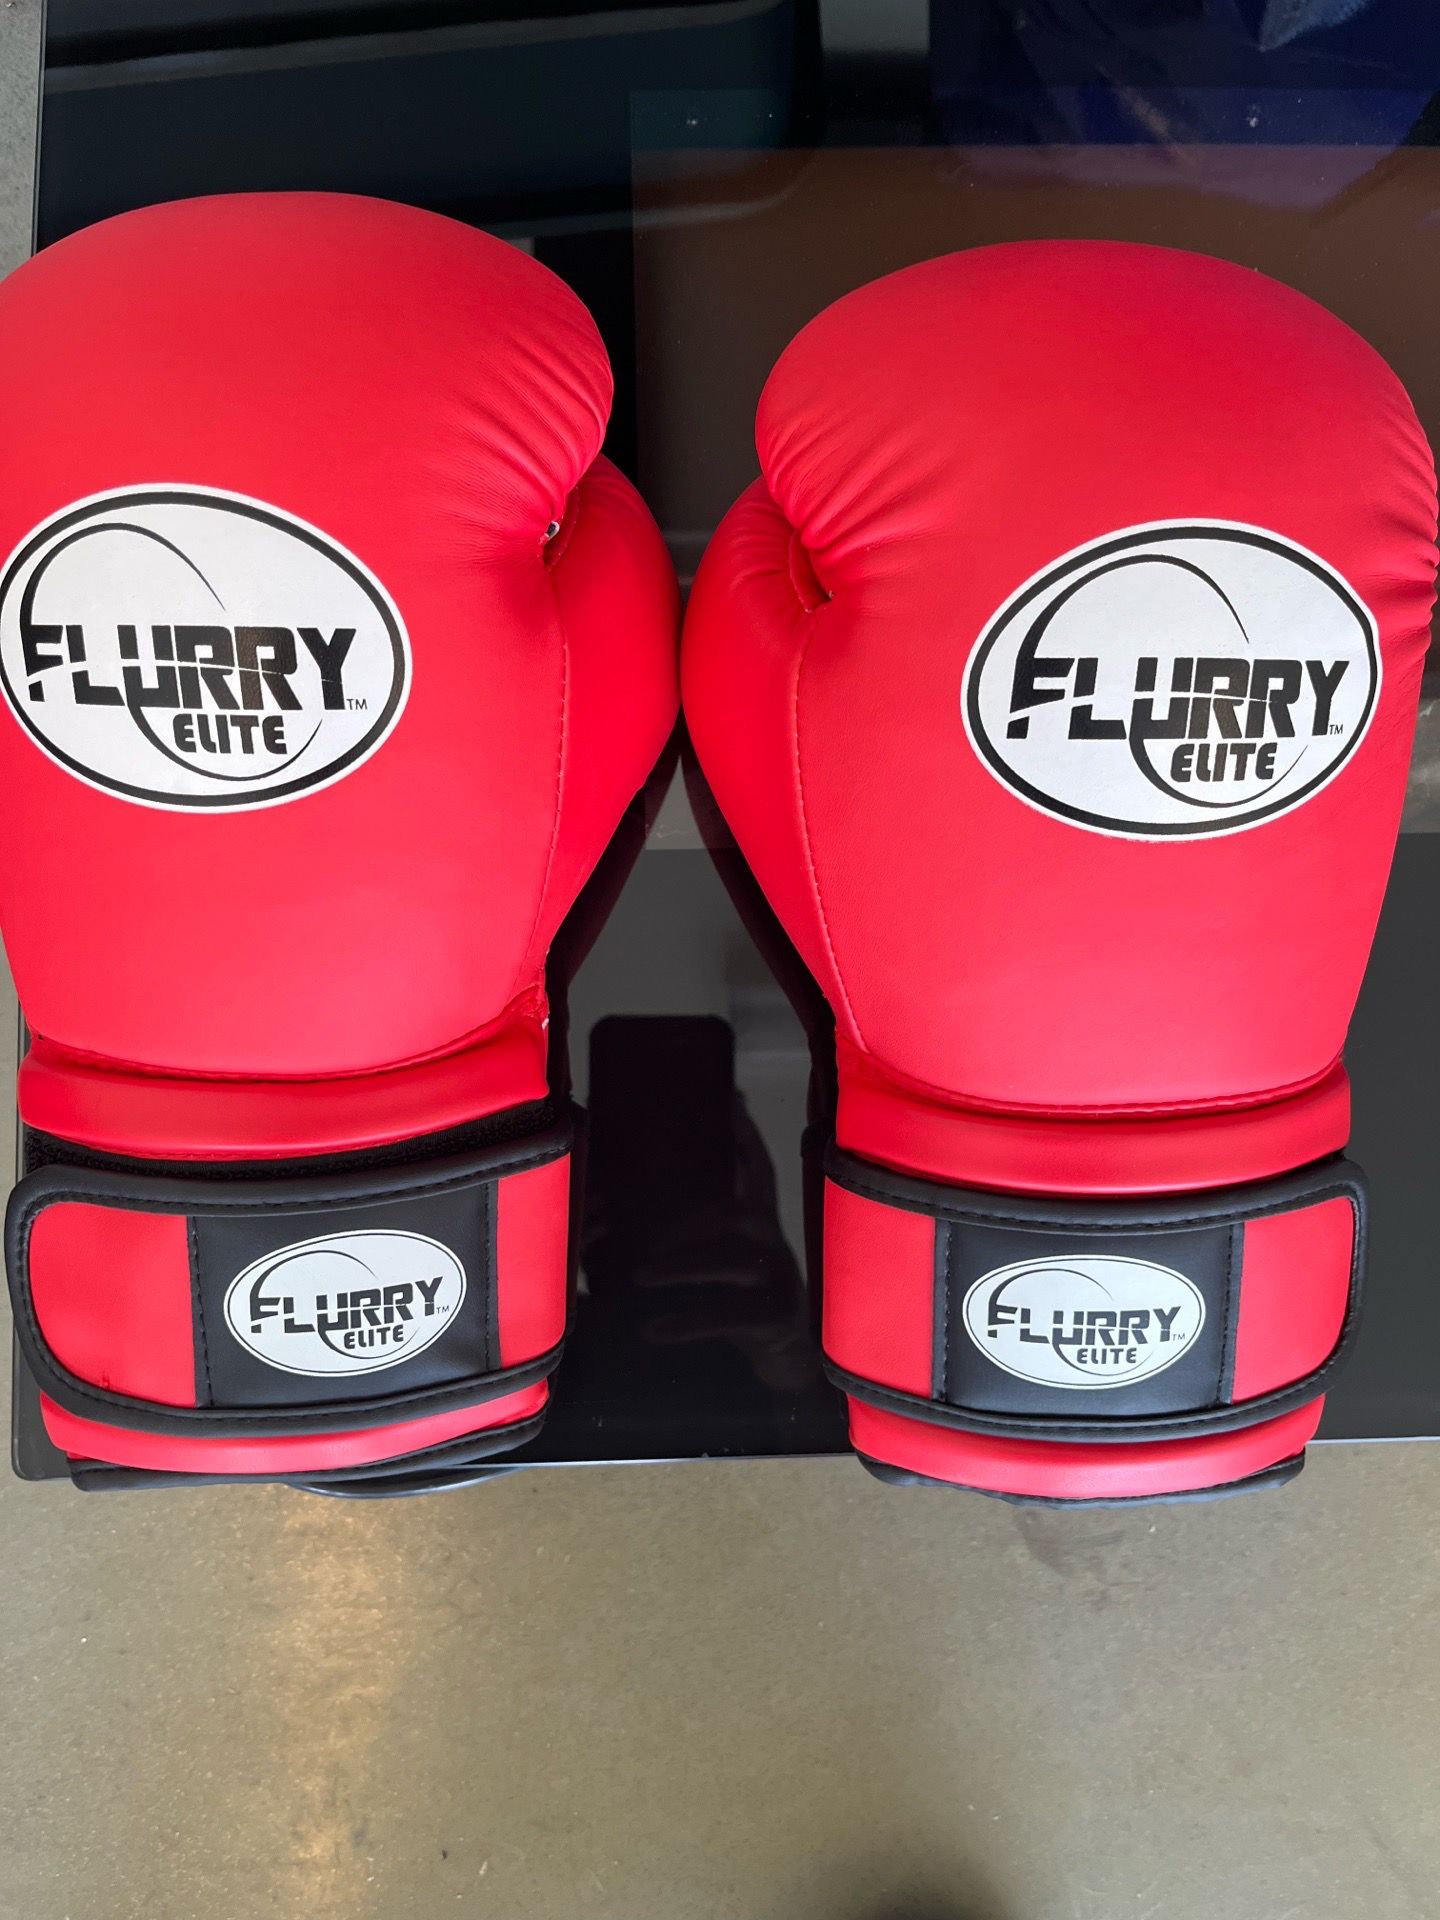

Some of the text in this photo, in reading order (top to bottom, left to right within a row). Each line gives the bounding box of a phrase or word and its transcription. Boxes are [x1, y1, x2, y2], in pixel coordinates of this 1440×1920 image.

[21, 624, 357, 711] FLURRY
[1006, 656, 1350, 740] FLURRY
[172, 713, 288, 755] ELITE
[1169, 742, 1278, 783] ELITE
[250, 1276, 443, 1334] FLURRY
[987, 1304, 1182, 1346] FLURRY
[343, 1323, 404, 1350] ELITE
[1076, 1347, 1138, 1365] ELITE
